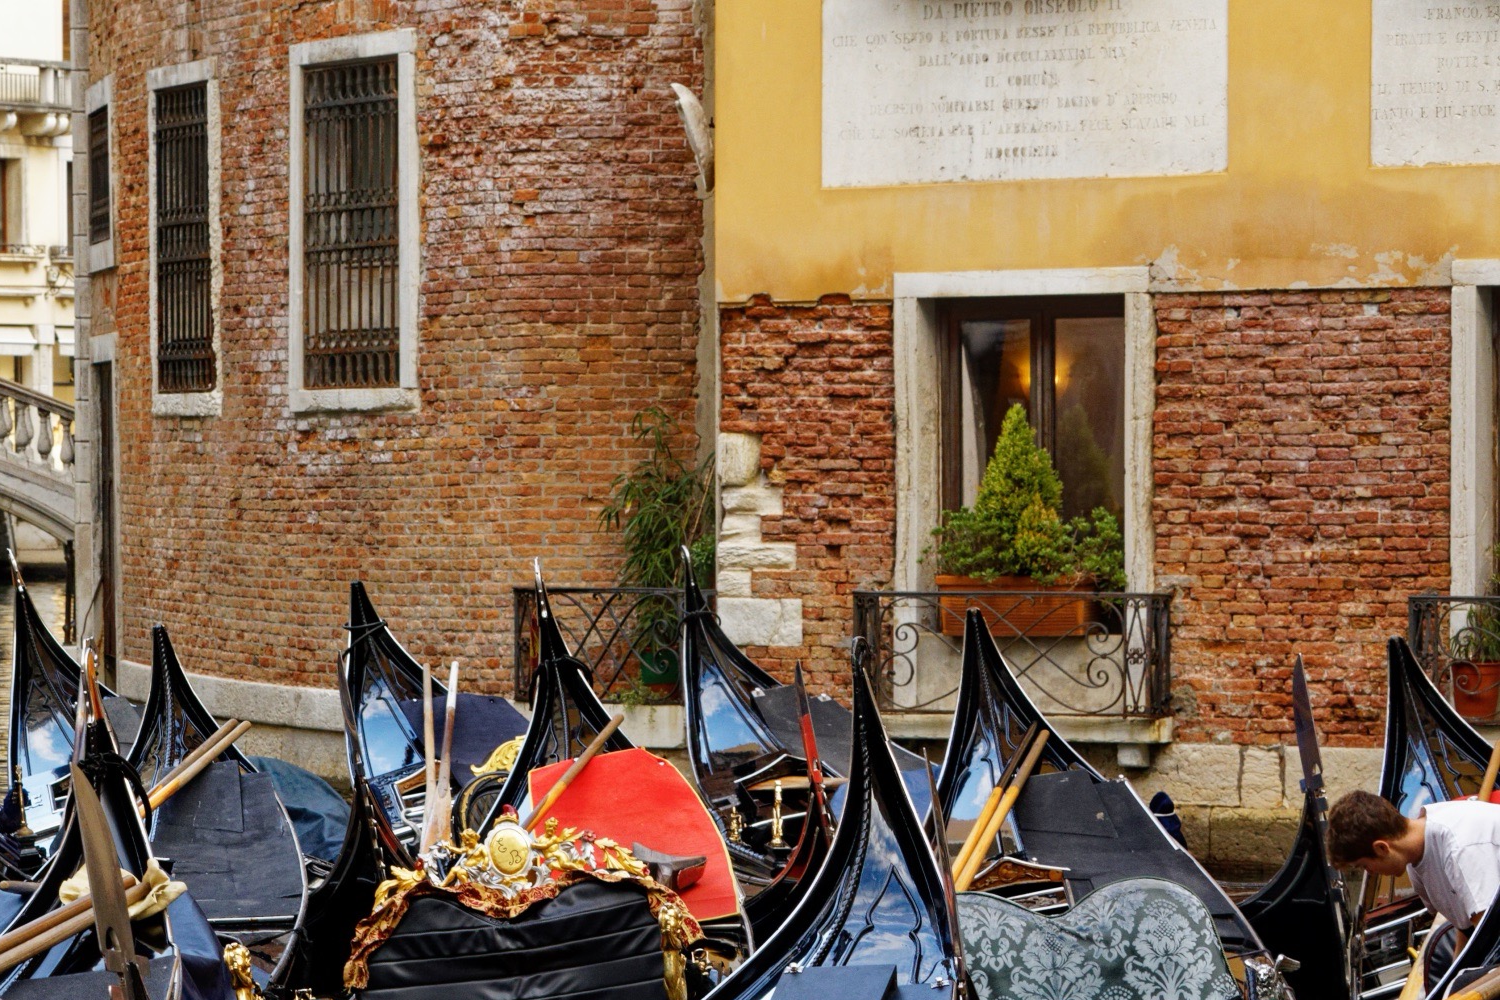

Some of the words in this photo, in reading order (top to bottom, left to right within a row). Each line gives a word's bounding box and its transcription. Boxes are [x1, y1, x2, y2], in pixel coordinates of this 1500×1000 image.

[923, 5, 944, 20] DA
[953, 1, 1013, 19] PIETRO
[1024, 0, 1098, 15] ORSEOLO
[832, 35, 857, 48] CHE
[866, 34, 888, 46] CON
[955, 28, 1009, 42] FORTUNA
[1064, 25, 1080, 36] LA
[1088, 21, 1161, 35] REPUBBLICA
[1169, 18, 1217, 31] VENETA
[985, 76, 998, 88] IL
